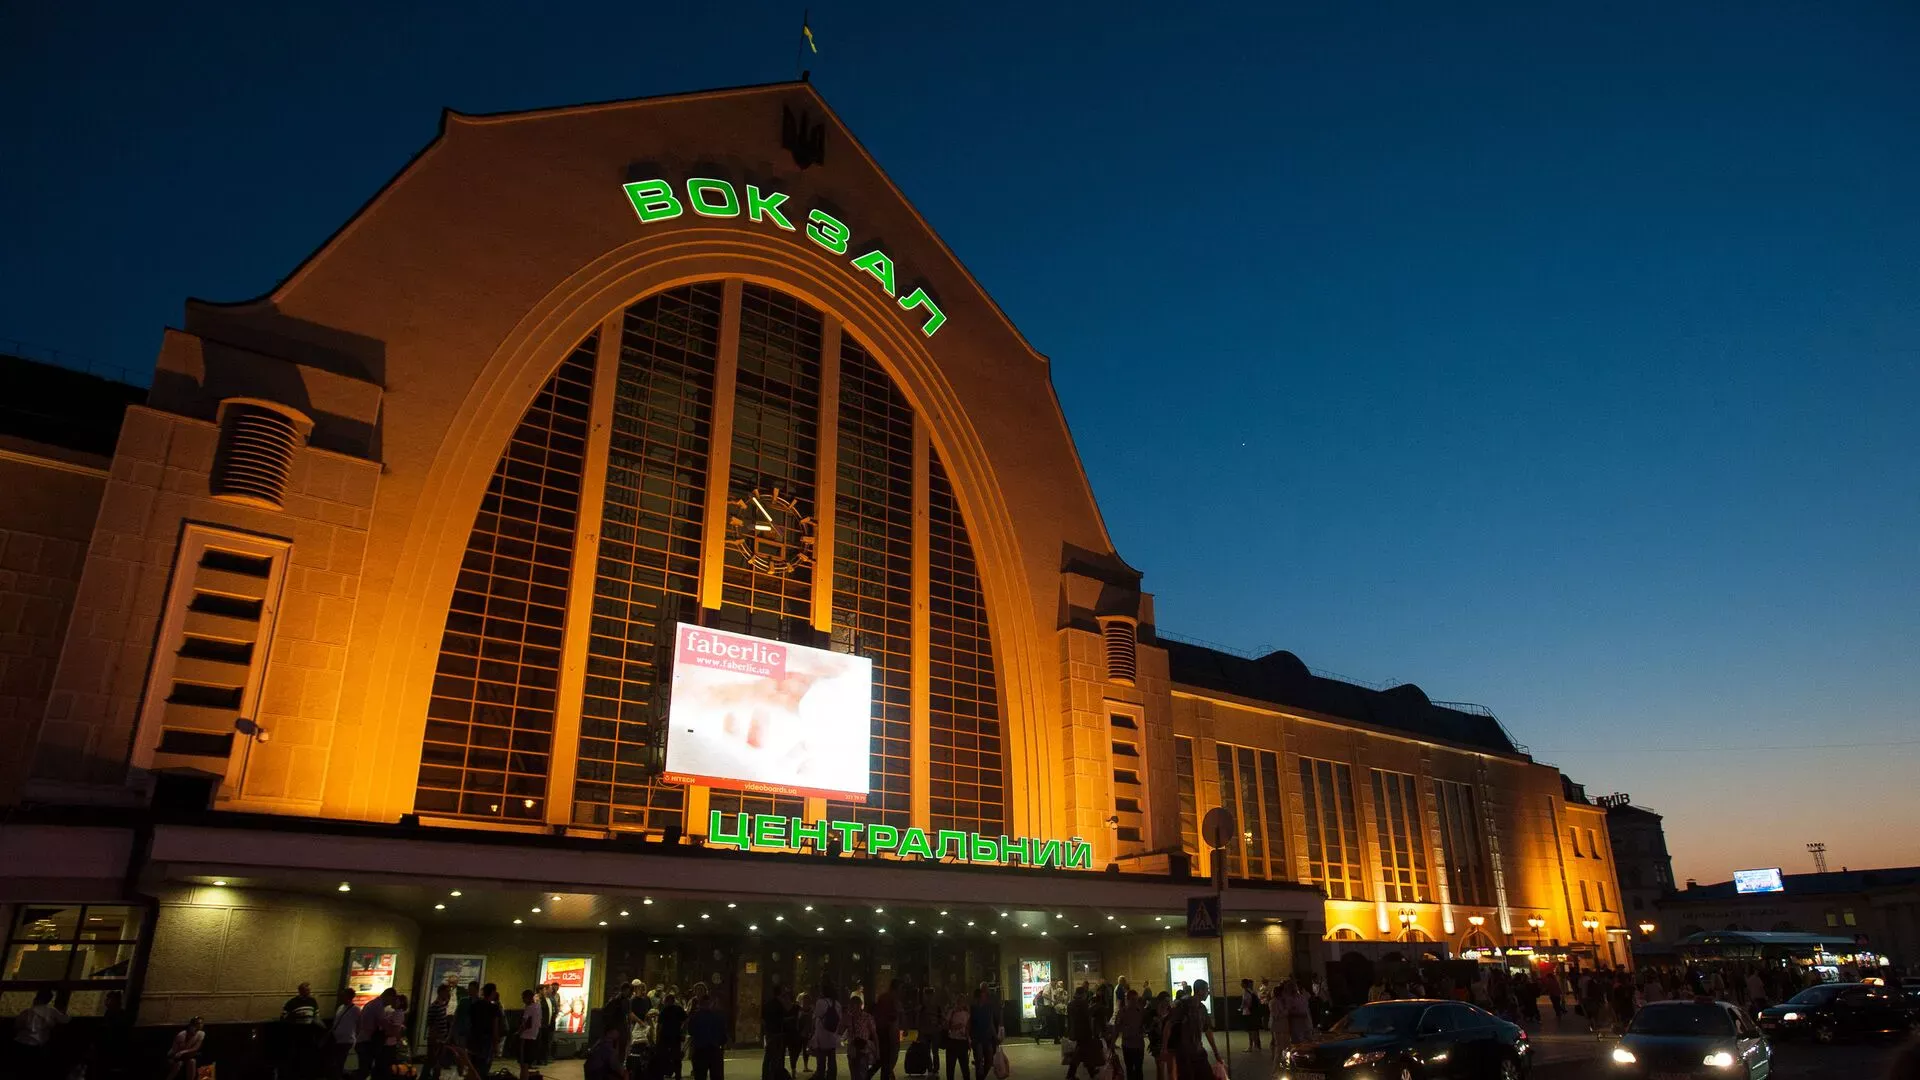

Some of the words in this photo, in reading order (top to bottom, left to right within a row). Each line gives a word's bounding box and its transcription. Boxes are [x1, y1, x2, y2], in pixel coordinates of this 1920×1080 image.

[622, 178, 947, 337] ВОКЗАЛ
[687, 632, 781, 666] faberlic
[696, 656, 770, 675] www.faberlic.ua
[744, 783, 798, 794] videoboards.ua
[709, 810, 1092, 868] ЦЕНТРАЛЬНИЙ
